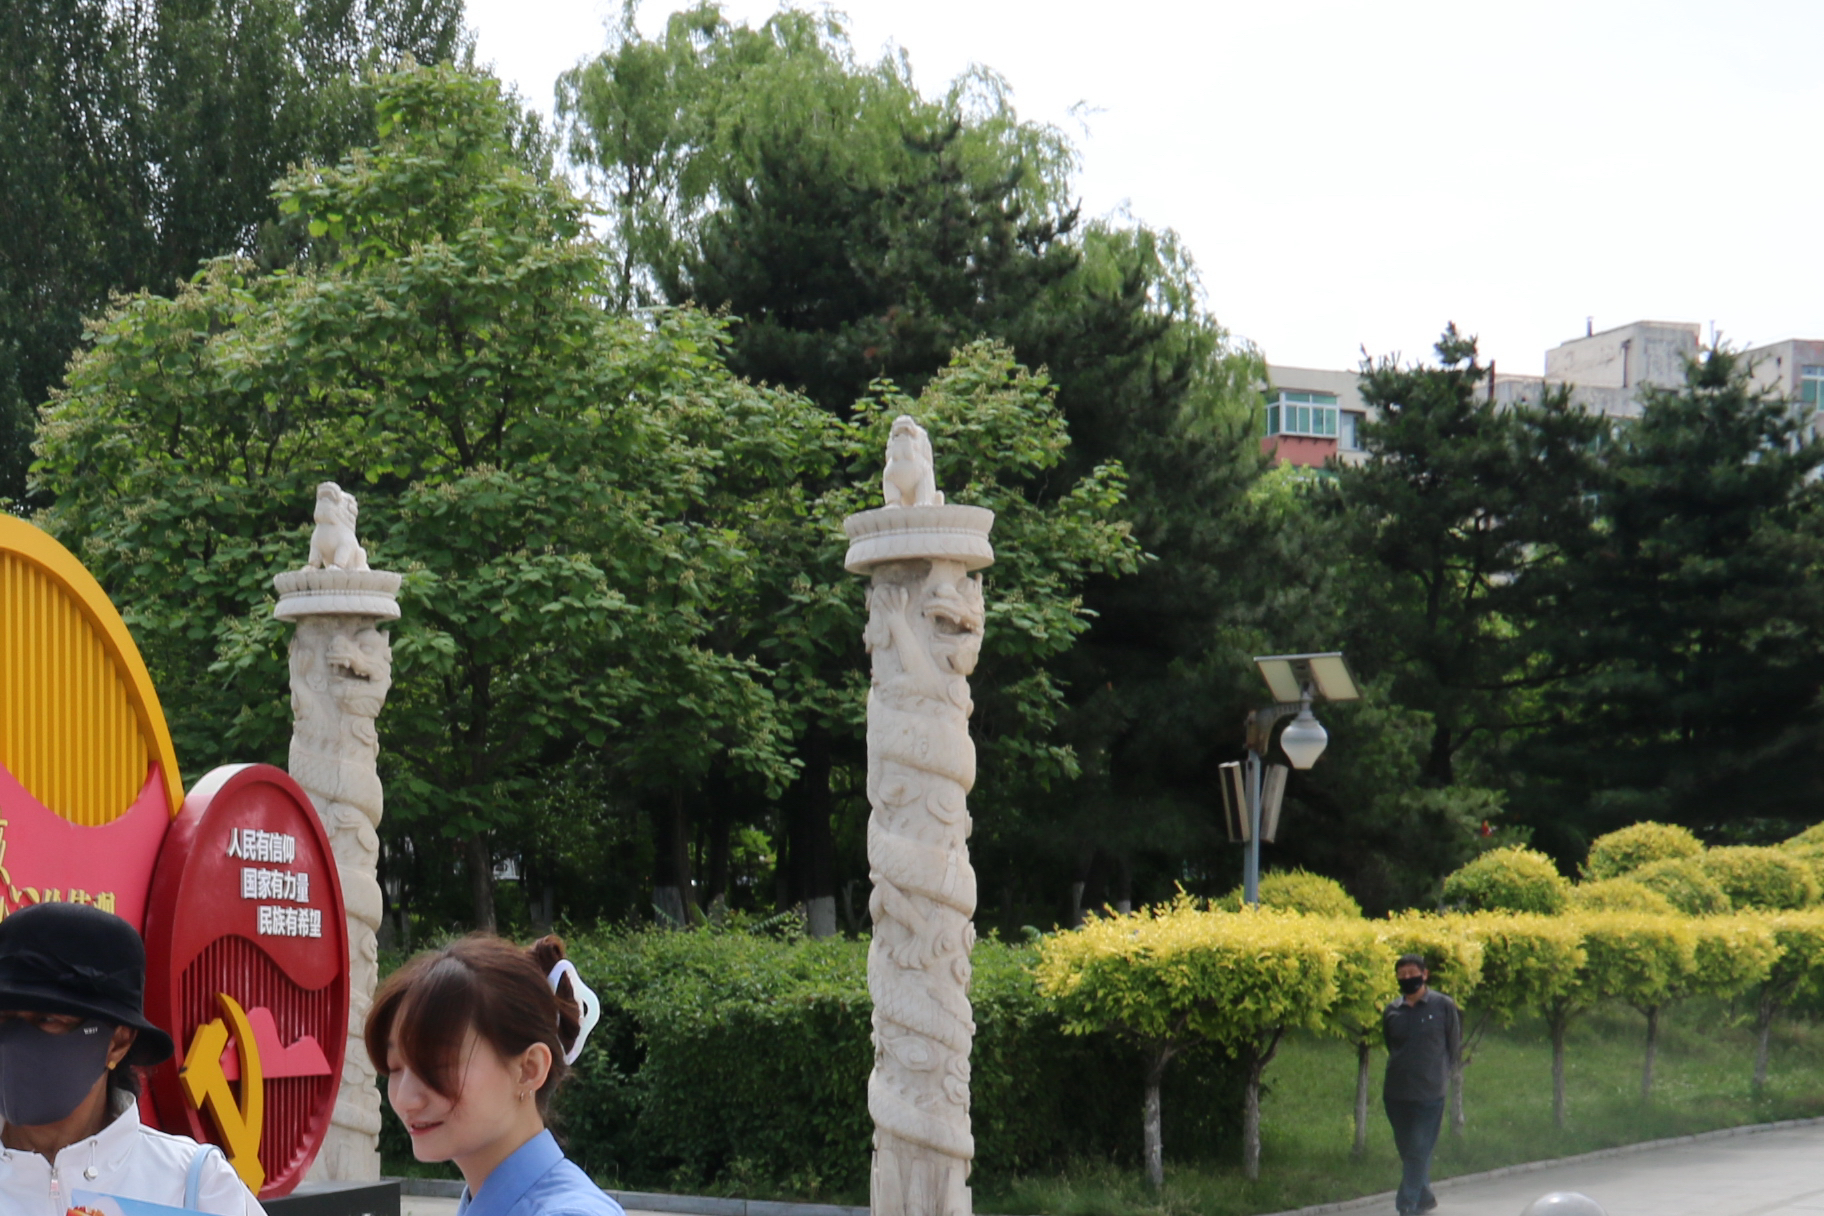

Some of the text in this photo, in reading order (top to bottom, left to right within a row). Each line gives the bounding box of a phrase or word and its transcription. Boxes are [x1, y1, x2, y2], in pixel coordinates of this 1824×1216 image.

[227, 827, 295, 864] 人民有信仰
[241, 867, 309, 903] 国家有力量
[258, 905, 322, 938] 民族有希望
